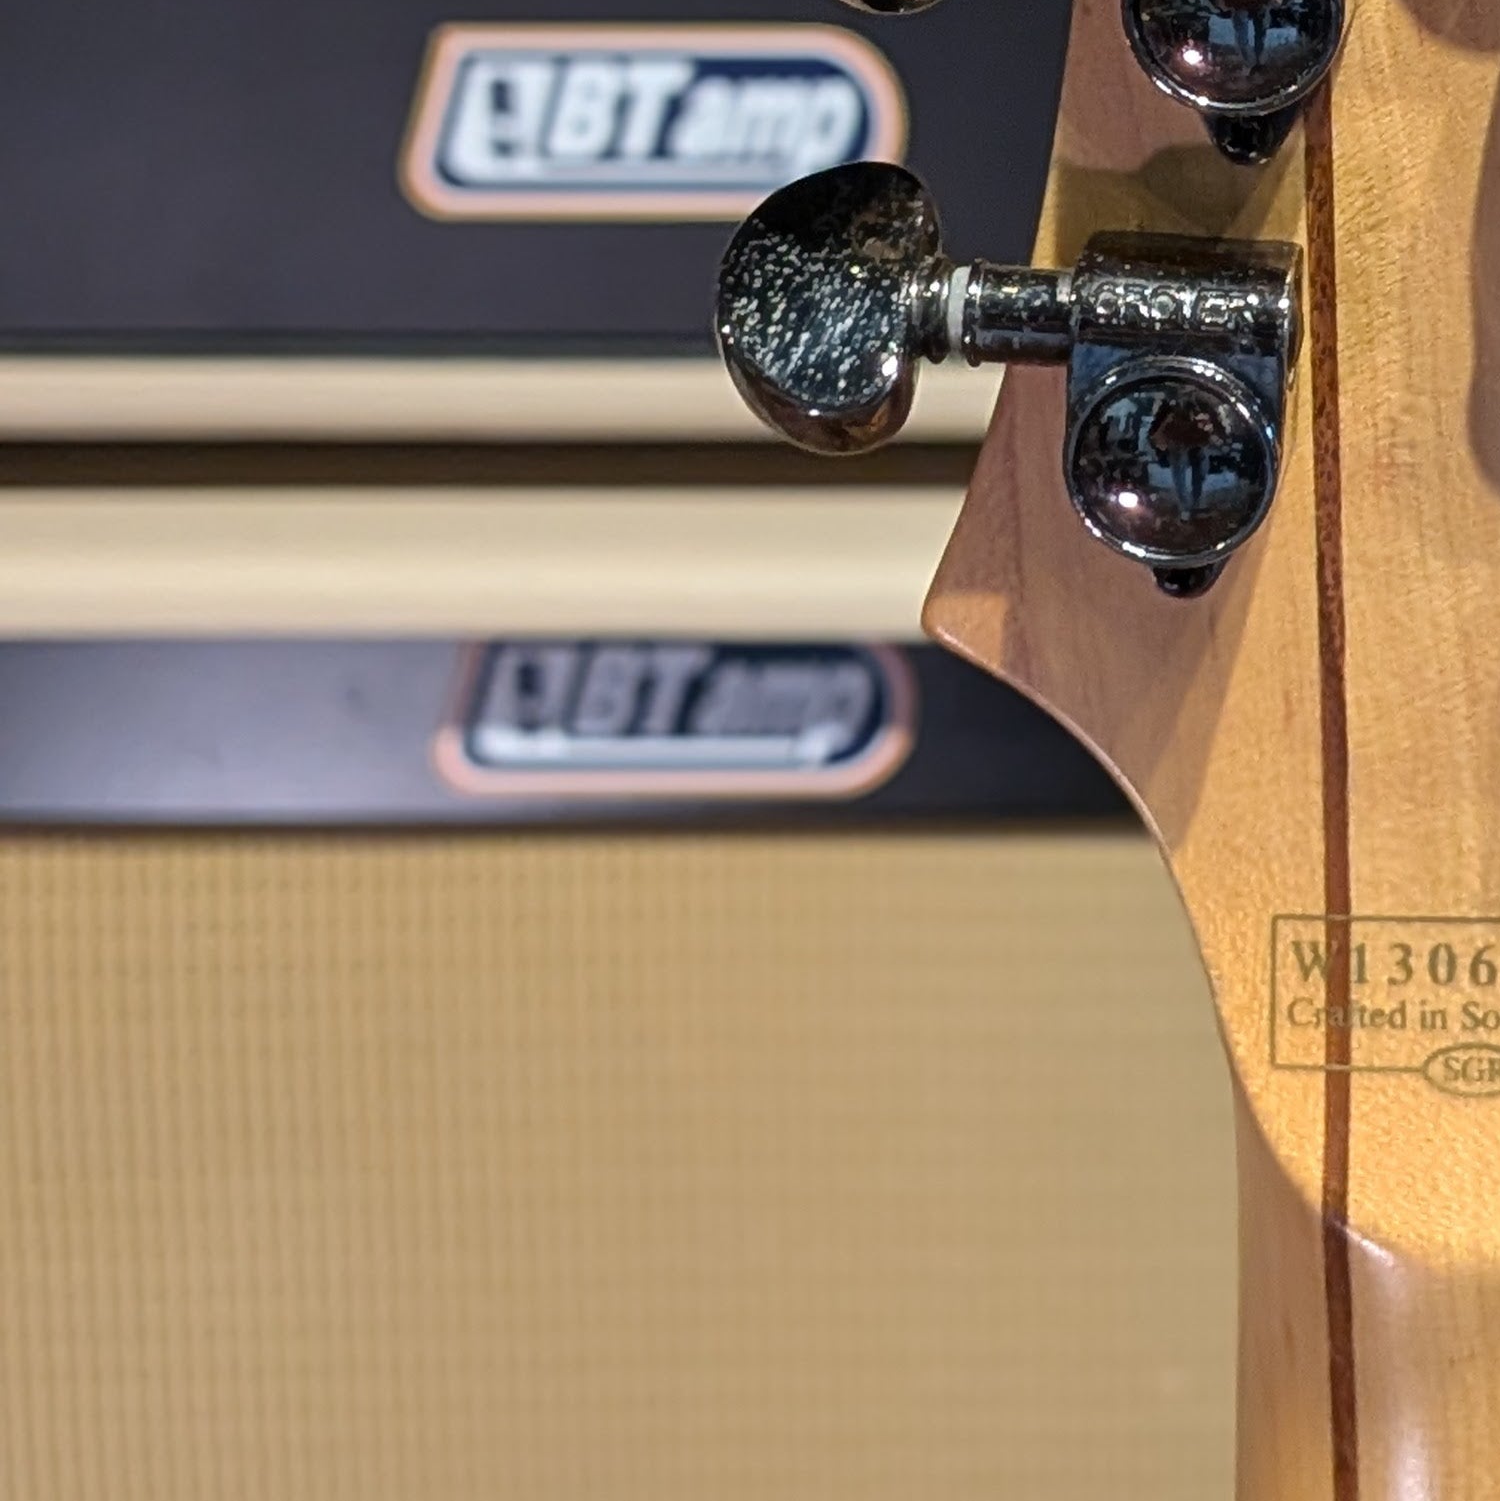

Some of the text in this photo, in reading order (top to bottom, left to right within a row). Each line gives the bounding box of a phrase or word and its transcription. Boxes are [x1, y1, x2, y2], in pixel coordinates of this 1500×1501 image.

[1096, 283, 1256, 329] GROVER
[1286, 999, 1408, 1032] Crafted
[1419, 1001, 1448, 1031] in
